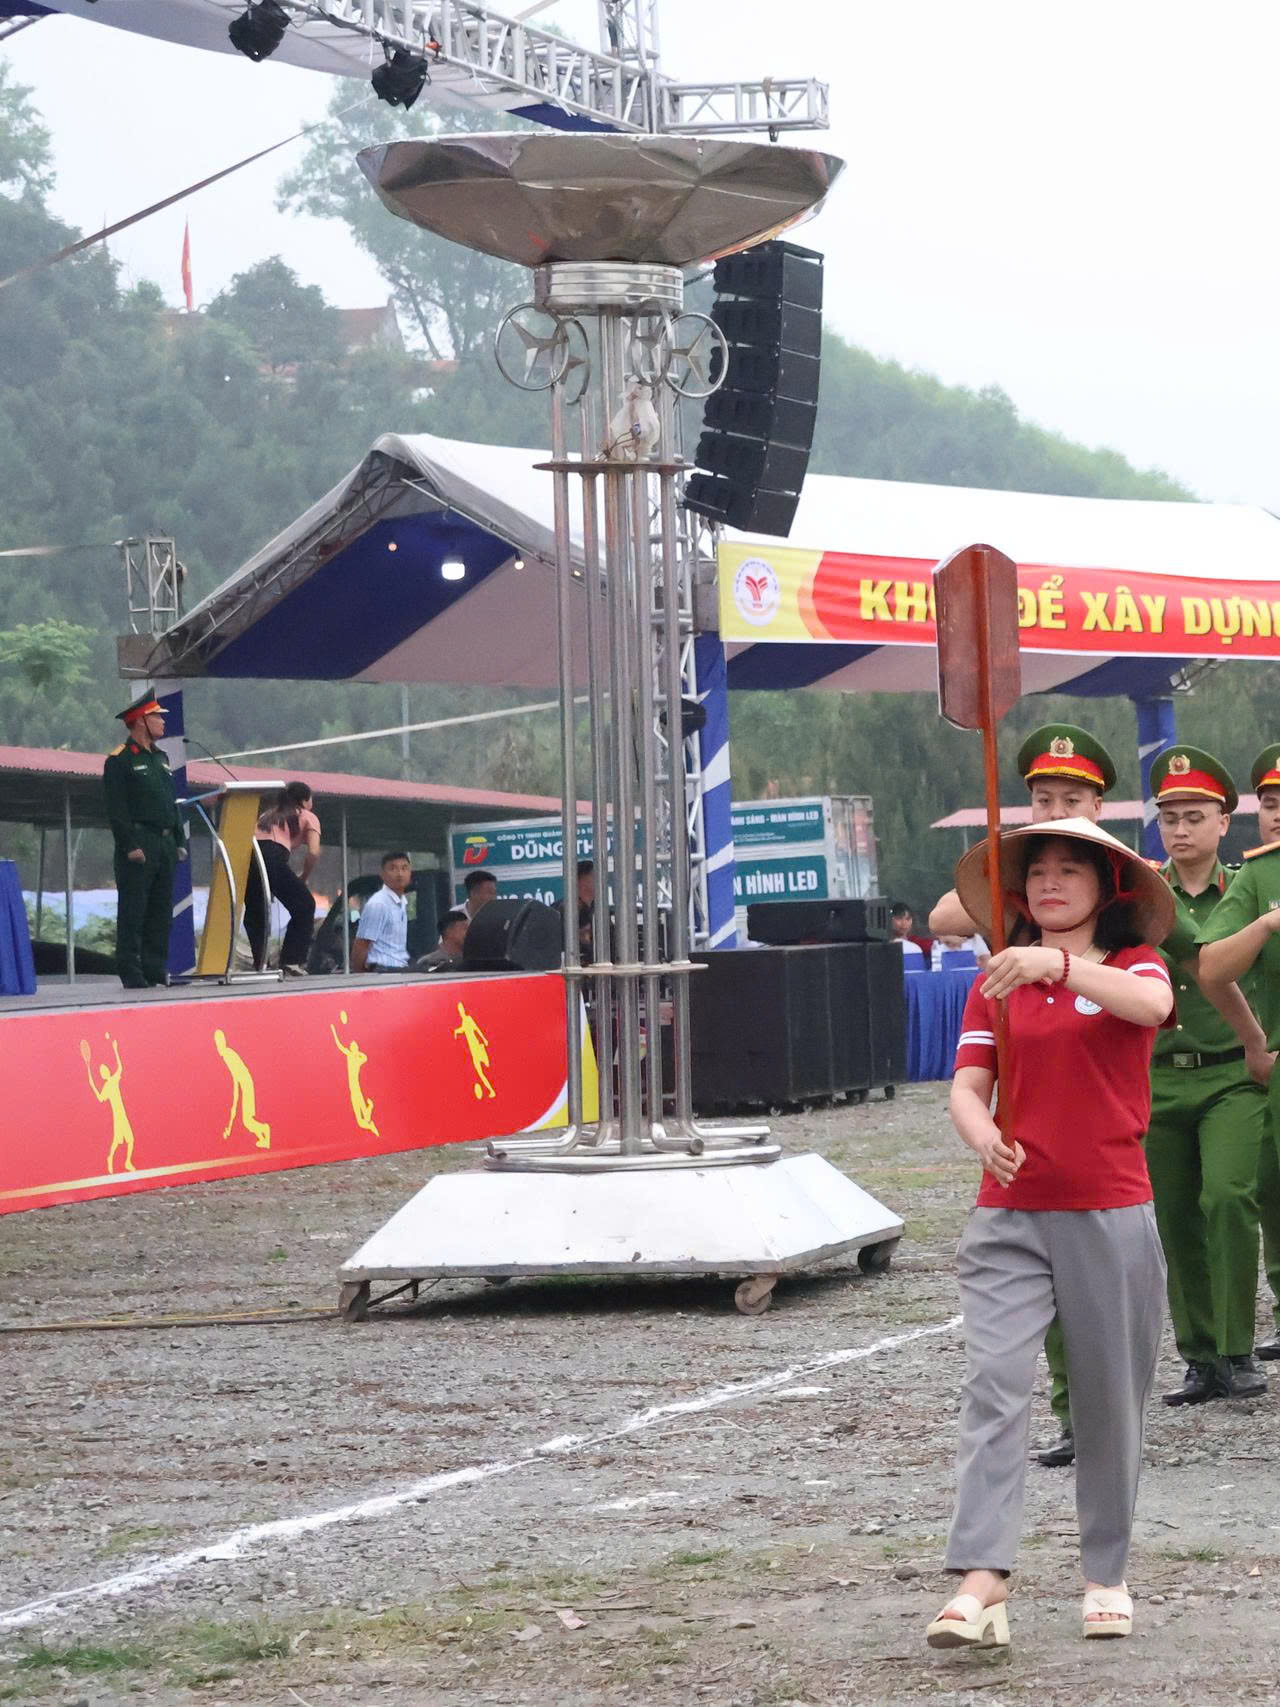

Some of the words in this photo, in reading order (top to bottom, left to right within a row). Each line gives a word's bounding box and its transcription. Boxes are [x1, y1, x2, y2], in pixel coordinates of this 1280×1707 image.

[859, 579, 936, 623] KH
[1080, 584, 1168, 634] XÂY
[746, 870, 785, 895] HÌNH
[788, 870, 818, 892] LED
